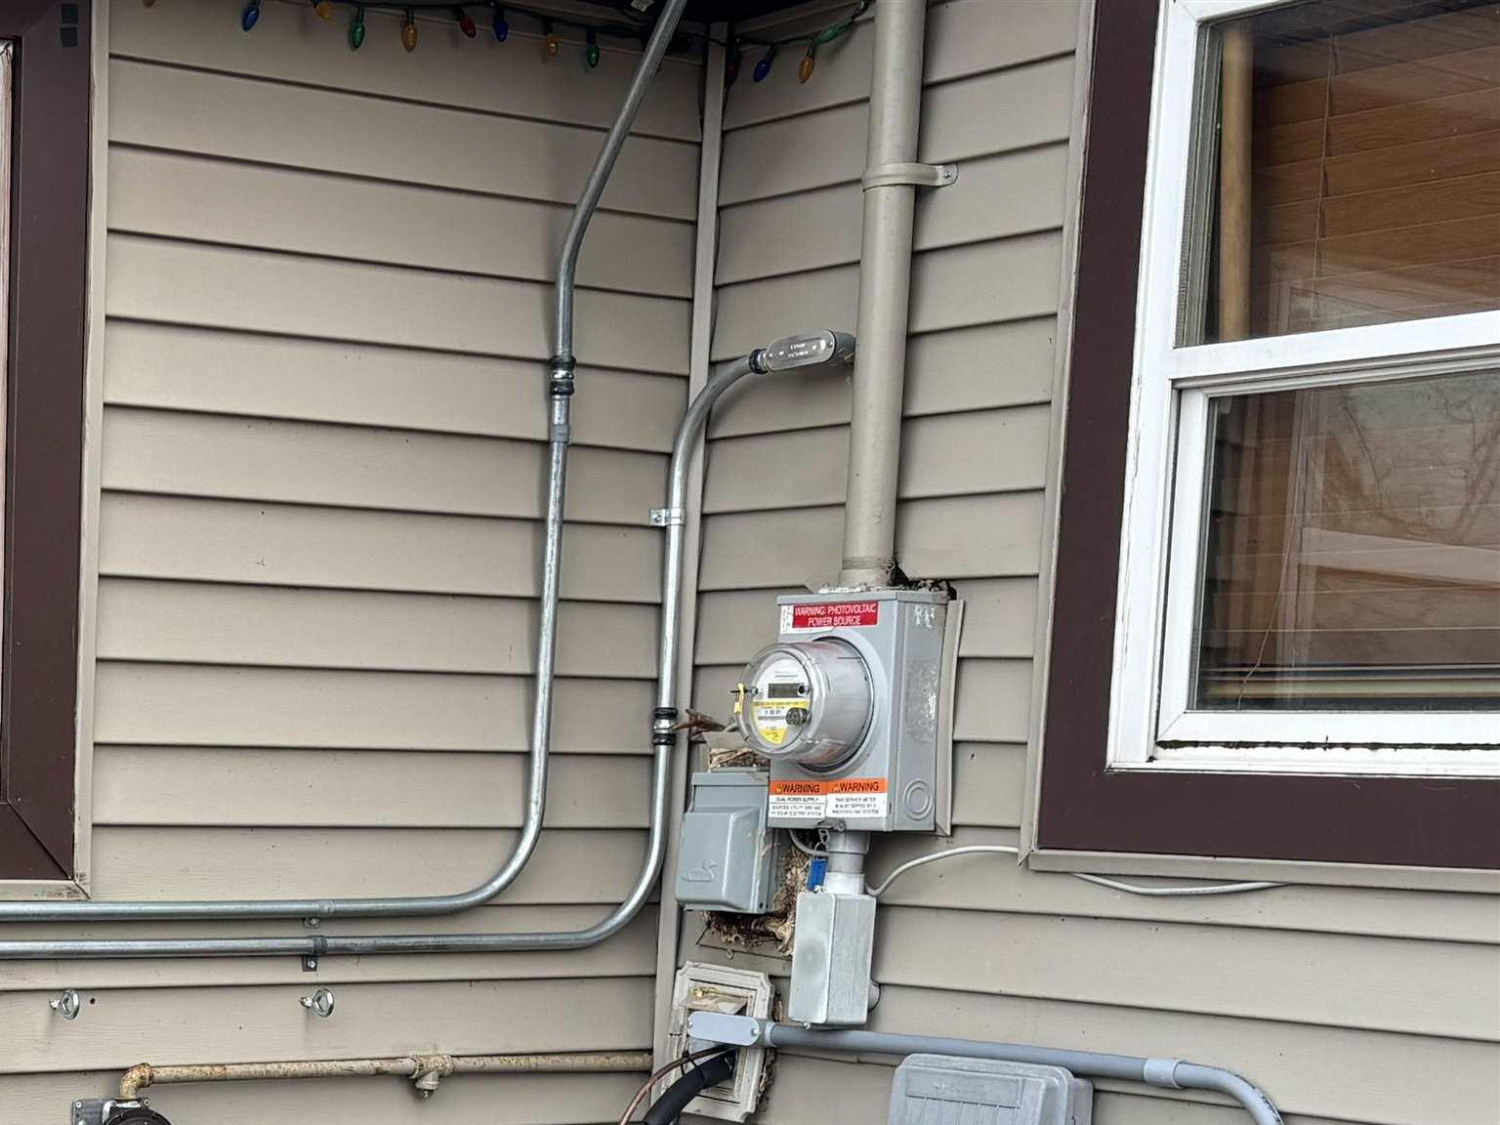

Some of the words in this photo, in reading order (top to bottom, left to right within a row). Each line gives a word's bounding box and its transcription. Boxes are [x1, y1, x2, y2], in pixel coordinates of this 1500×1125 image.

[827, 603, 876, 615] PHOTOVOLTAIC
[808, 616, 832, 626] POWER
[833, 616, 861, 626] SOURCE
[782, 784, 820, 793] WARNING
[840, 781, 879, 792] WARNING
